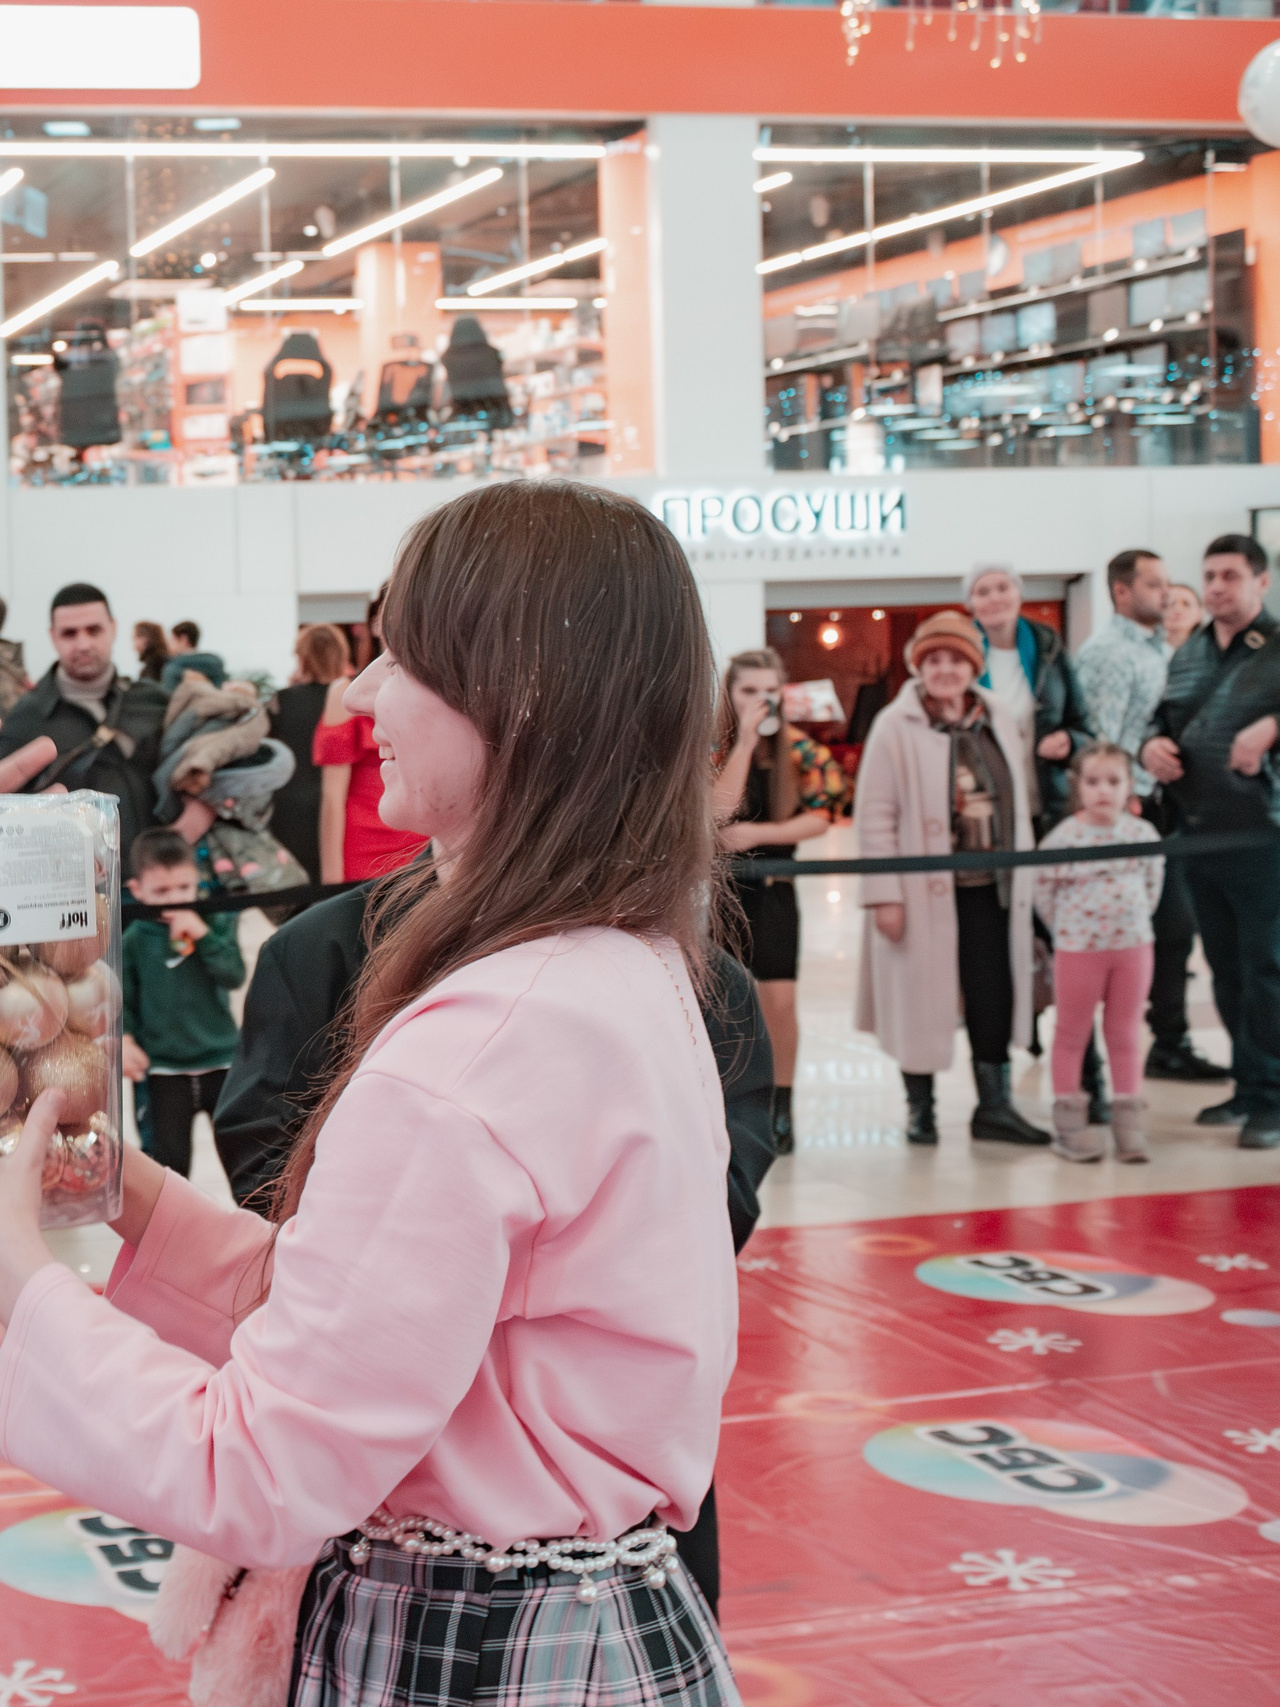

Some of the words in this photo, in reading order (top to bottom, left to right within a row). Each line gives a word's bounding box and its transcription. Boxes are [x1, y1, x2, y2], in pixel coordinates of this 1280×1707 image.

[662, 492, 906, 537] ПРОСУШИ
[59, 910, 88, 930] Hoff
[927, 1426, 1107, 1493] СБС
